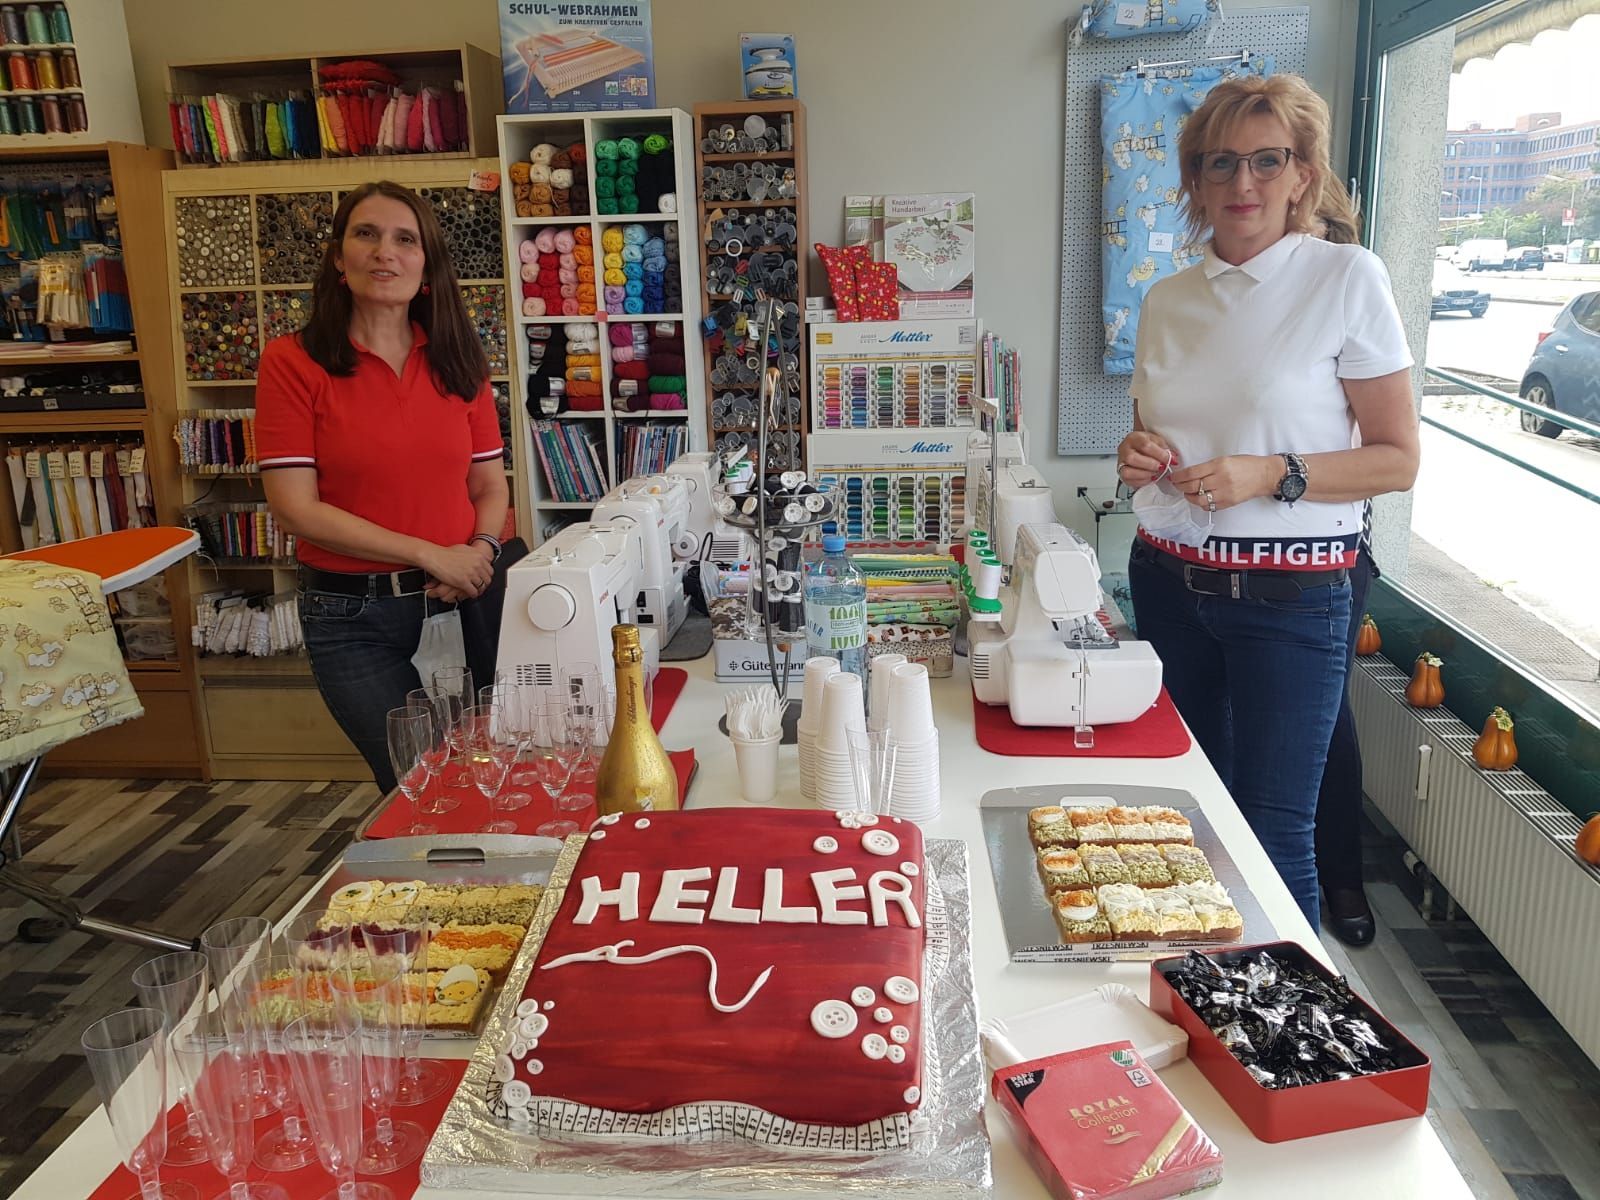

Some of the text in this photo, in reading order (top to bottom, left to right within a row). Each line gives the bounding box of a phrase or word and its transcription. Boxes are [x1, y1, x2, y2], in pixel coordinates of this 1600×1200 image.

[509, 3, 638, 17] SCHUL-WEBRAHMEN
[879, 331, 932, 343] Mettler
[900, 441, 952, 454] Mettler
[1198, 540, 1345, 566] HILFIGER
[573, 867, 921, 927] HELLER
[1068, 1095, 1130, 1119] ROYAL
[1077, 1107, 1139, 1130] Collection
[1108, 1123, 1126, 1136] 20
